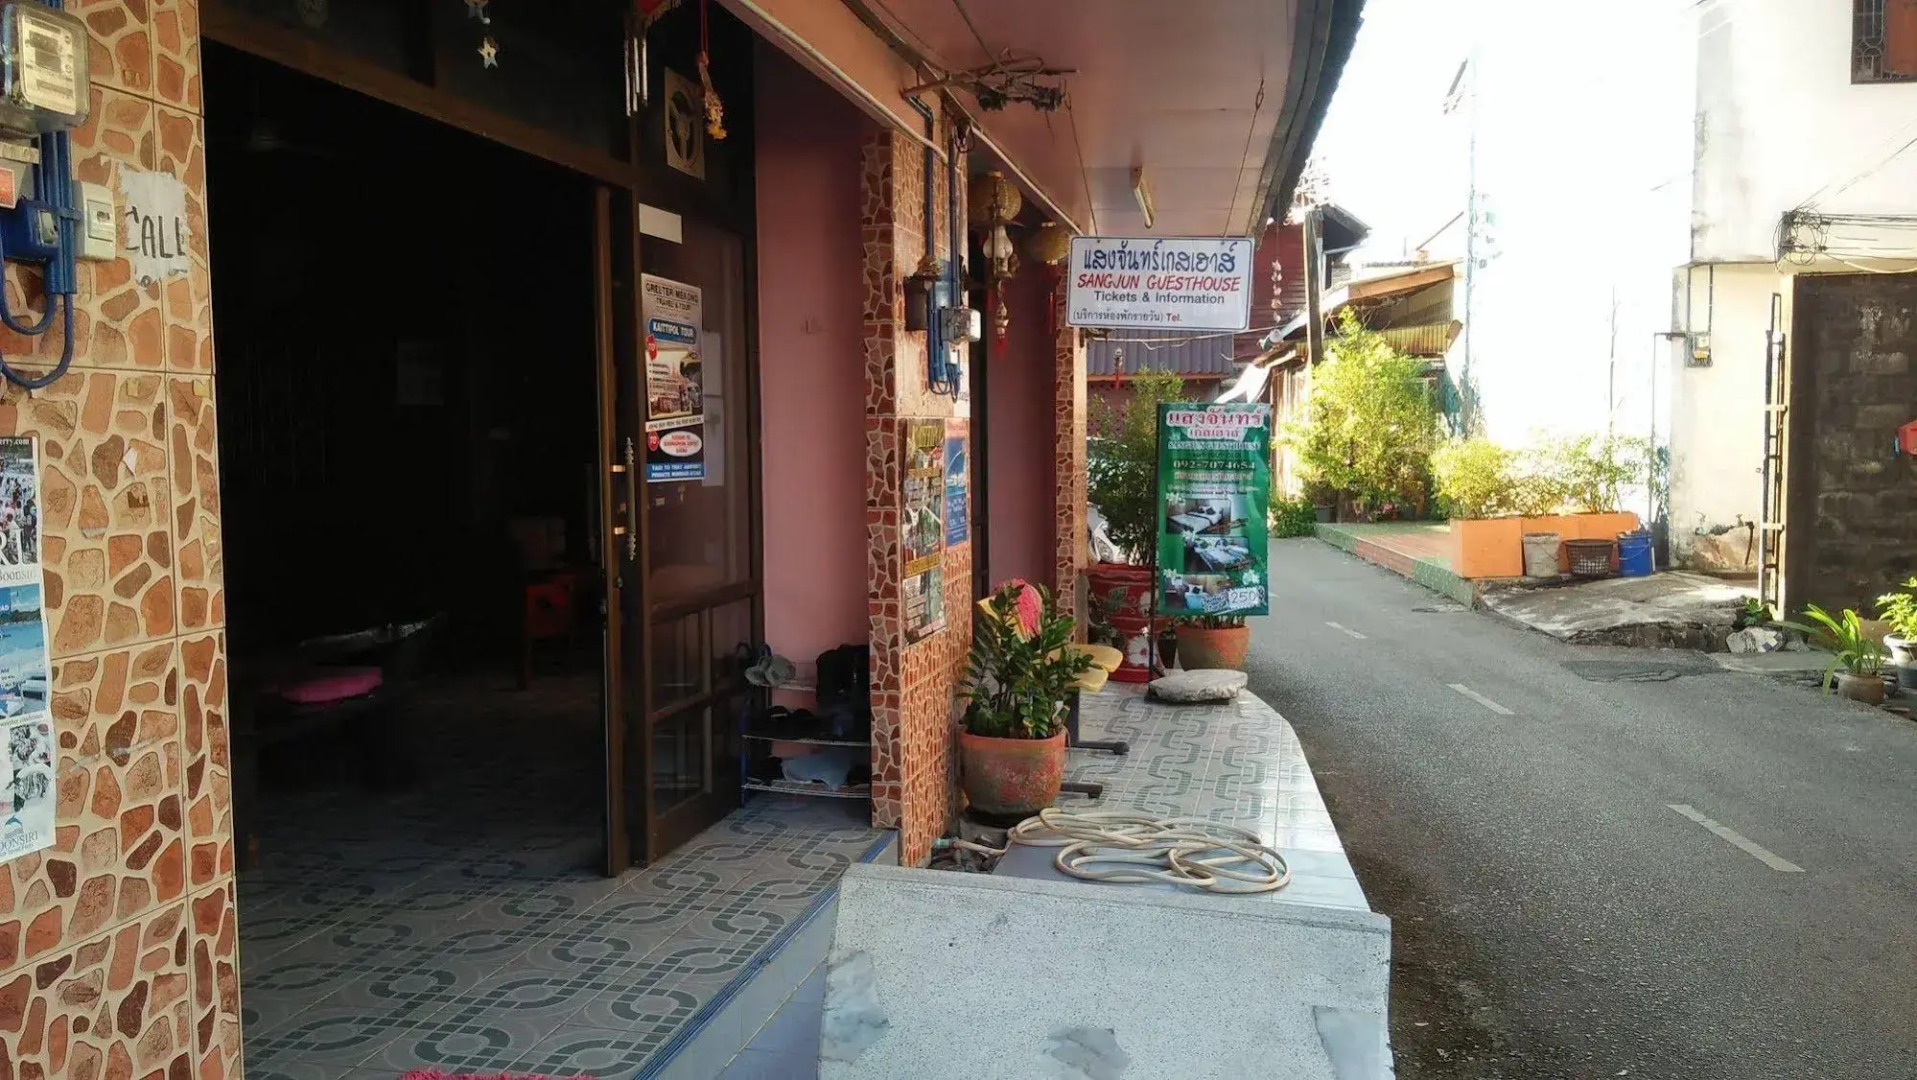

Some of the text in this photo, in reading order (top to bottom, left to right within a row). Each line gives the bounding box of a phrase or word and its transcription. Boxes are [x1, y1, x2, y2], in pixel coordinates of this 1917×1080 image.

[1077, 273, 1241, 292] SANGJUN GUESTHOUSE
[1094, 290, 1225, 304] Tickets & Information
[1166, 313, 1182, 322] Tel.
[1169, 407, 1262, 425] แสงจันทร์
[0, 570, 37, 581] oonsiri
[1230, 591, 1257, 603] 250
